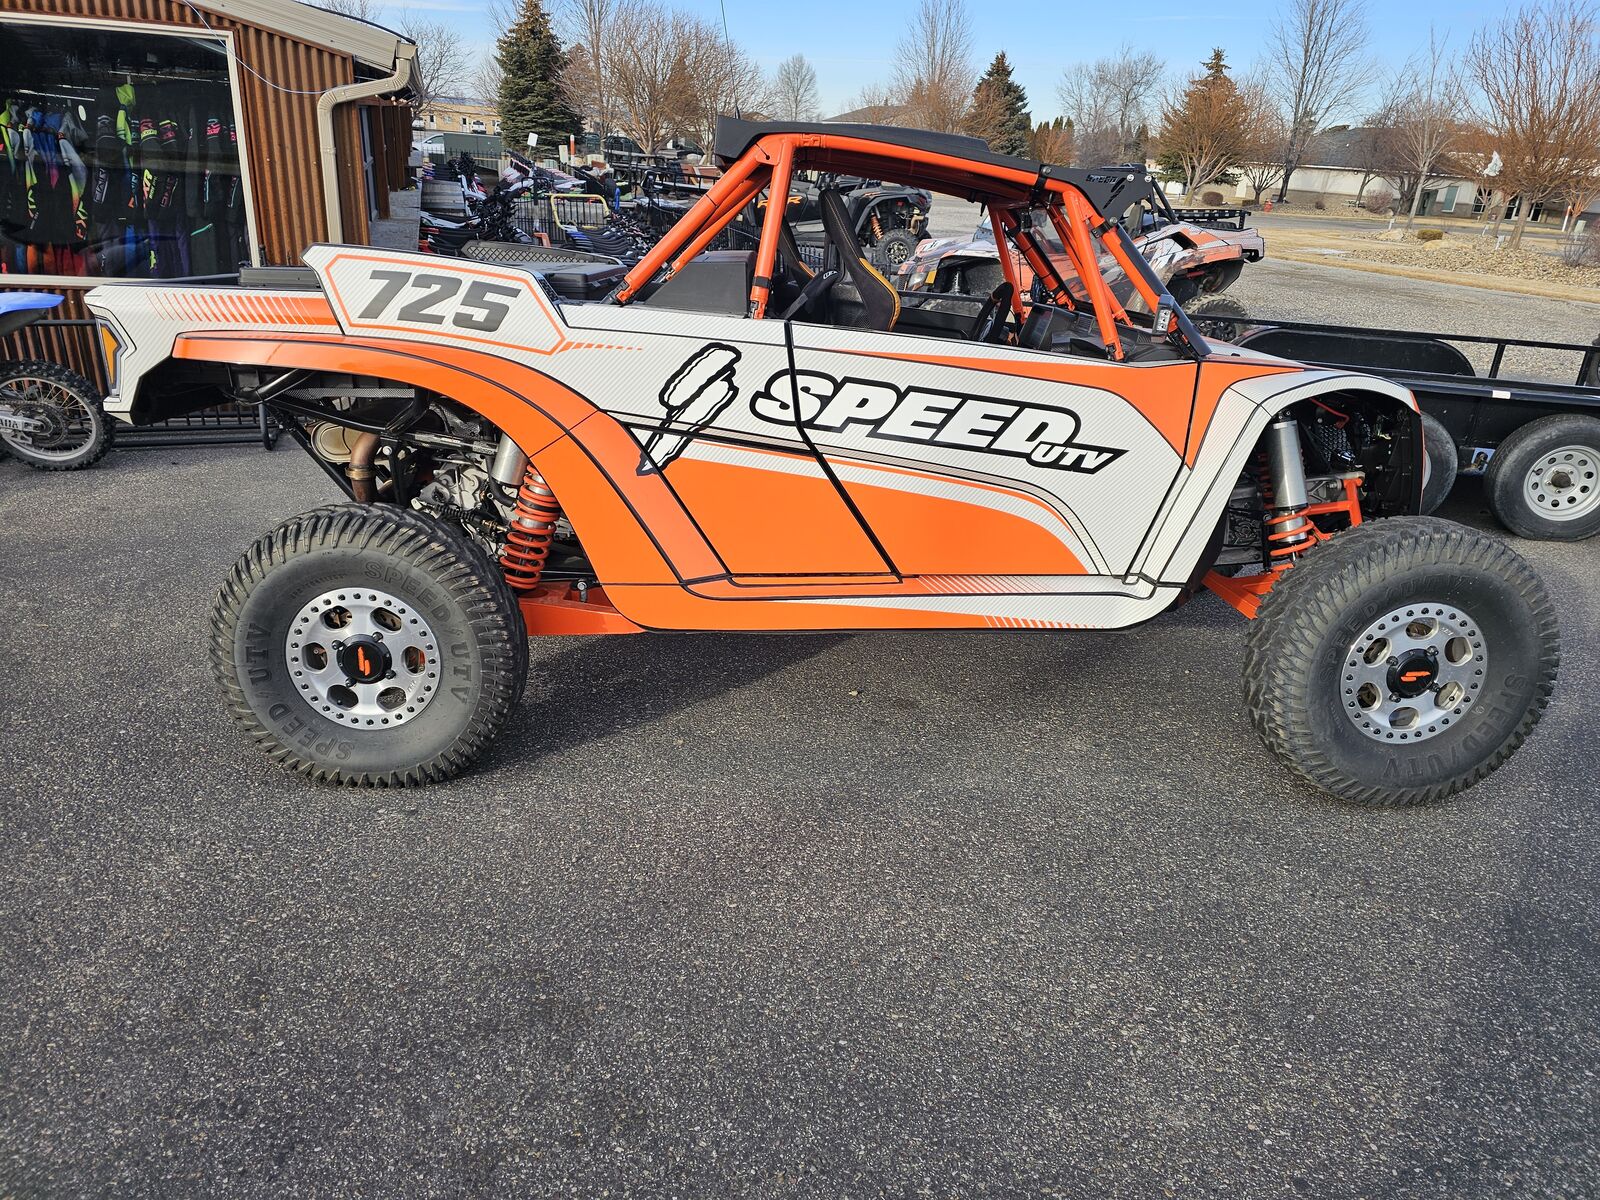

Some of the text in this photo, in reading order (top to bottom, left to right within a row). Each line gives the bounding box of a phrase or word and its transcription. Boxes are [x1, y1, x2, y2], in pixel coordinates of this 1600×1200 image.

[358, 270, 522, 333] 725
[751, 369, 1081, 458] SPEED
[1030, 443, 1128, 475] UTV
[364, 561, 472, 703] SPEED UTV
[1319, 601, 1380, 682] SPEED
[245, 622, 355, 760] SPEED UTV
[1383, 674, 1528, 777] SPEED UTV
